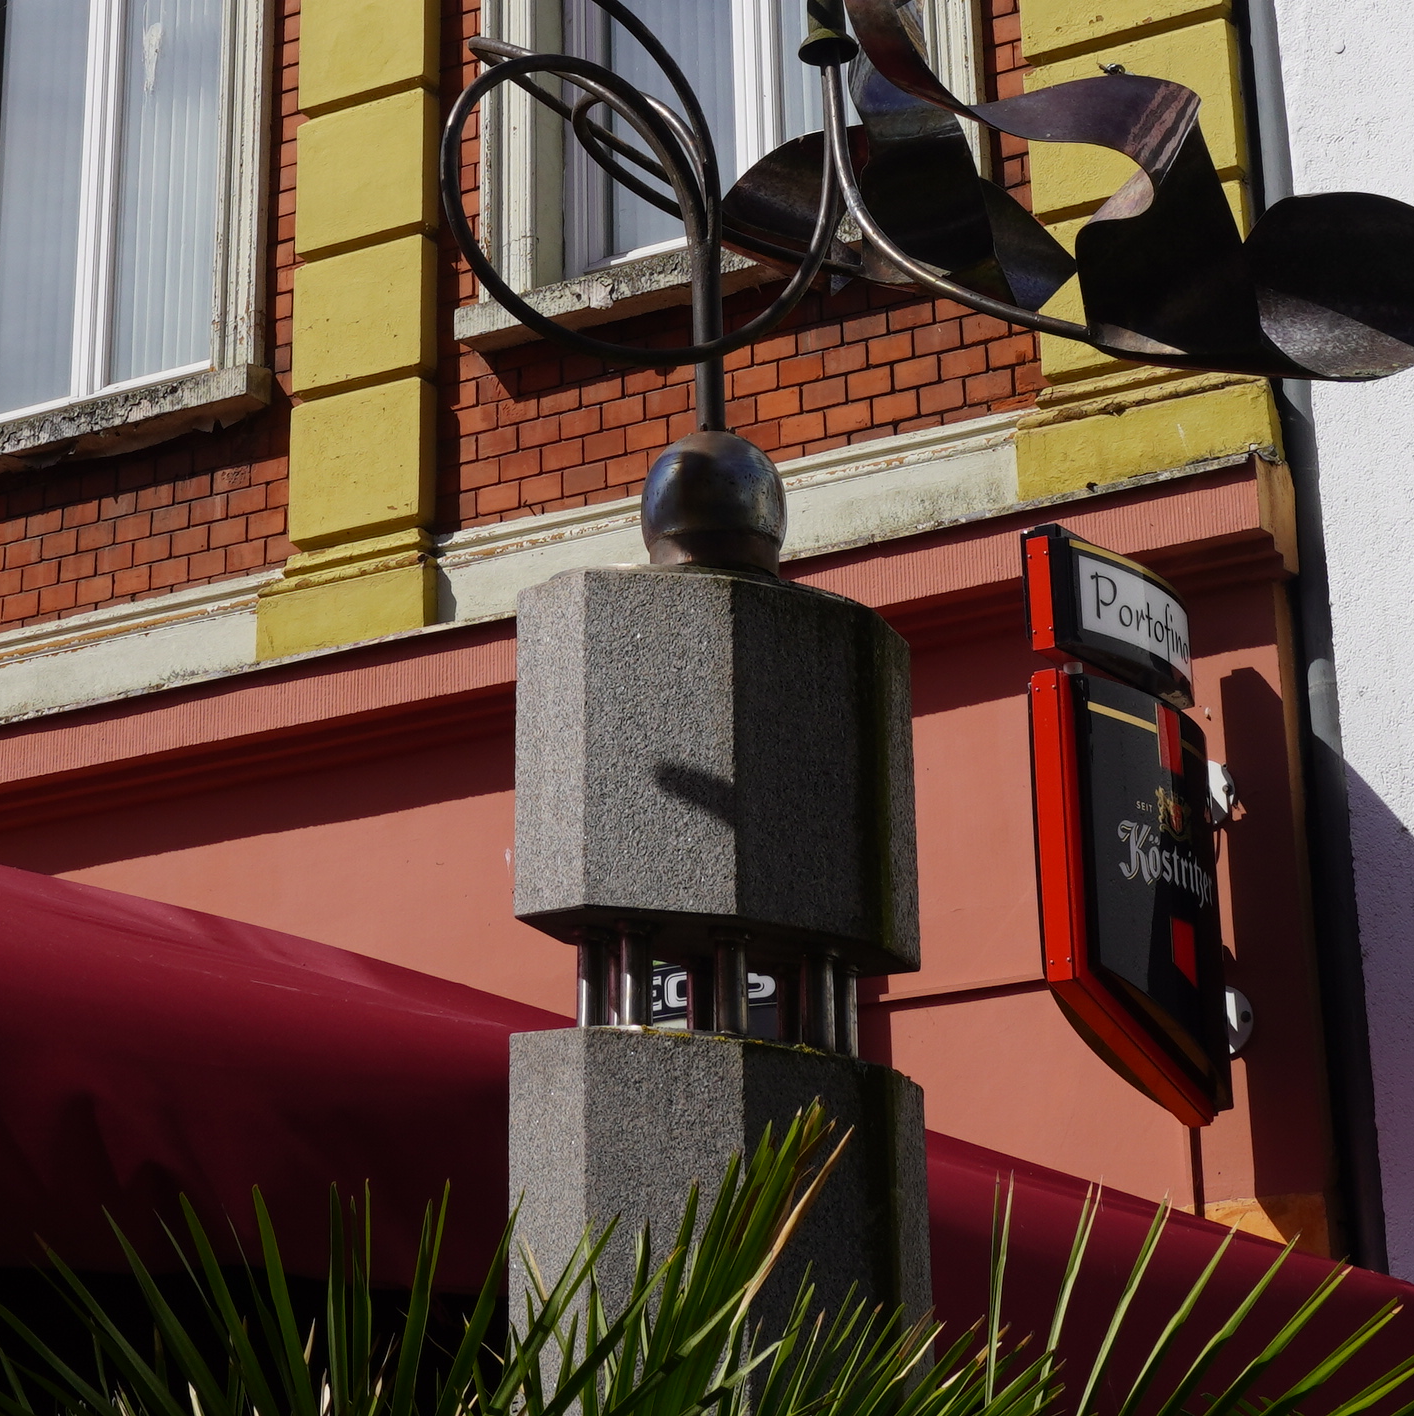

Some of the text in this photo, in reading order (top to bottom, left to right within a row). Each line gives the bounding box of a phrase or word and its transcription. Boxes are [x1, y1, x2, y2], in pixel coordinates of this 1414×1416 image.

[1090, 571, 1189, 664] Portofino
[1135, 800, 1154, 815] SEIT
[1117, 819, 1213, 908] Köstritzer
